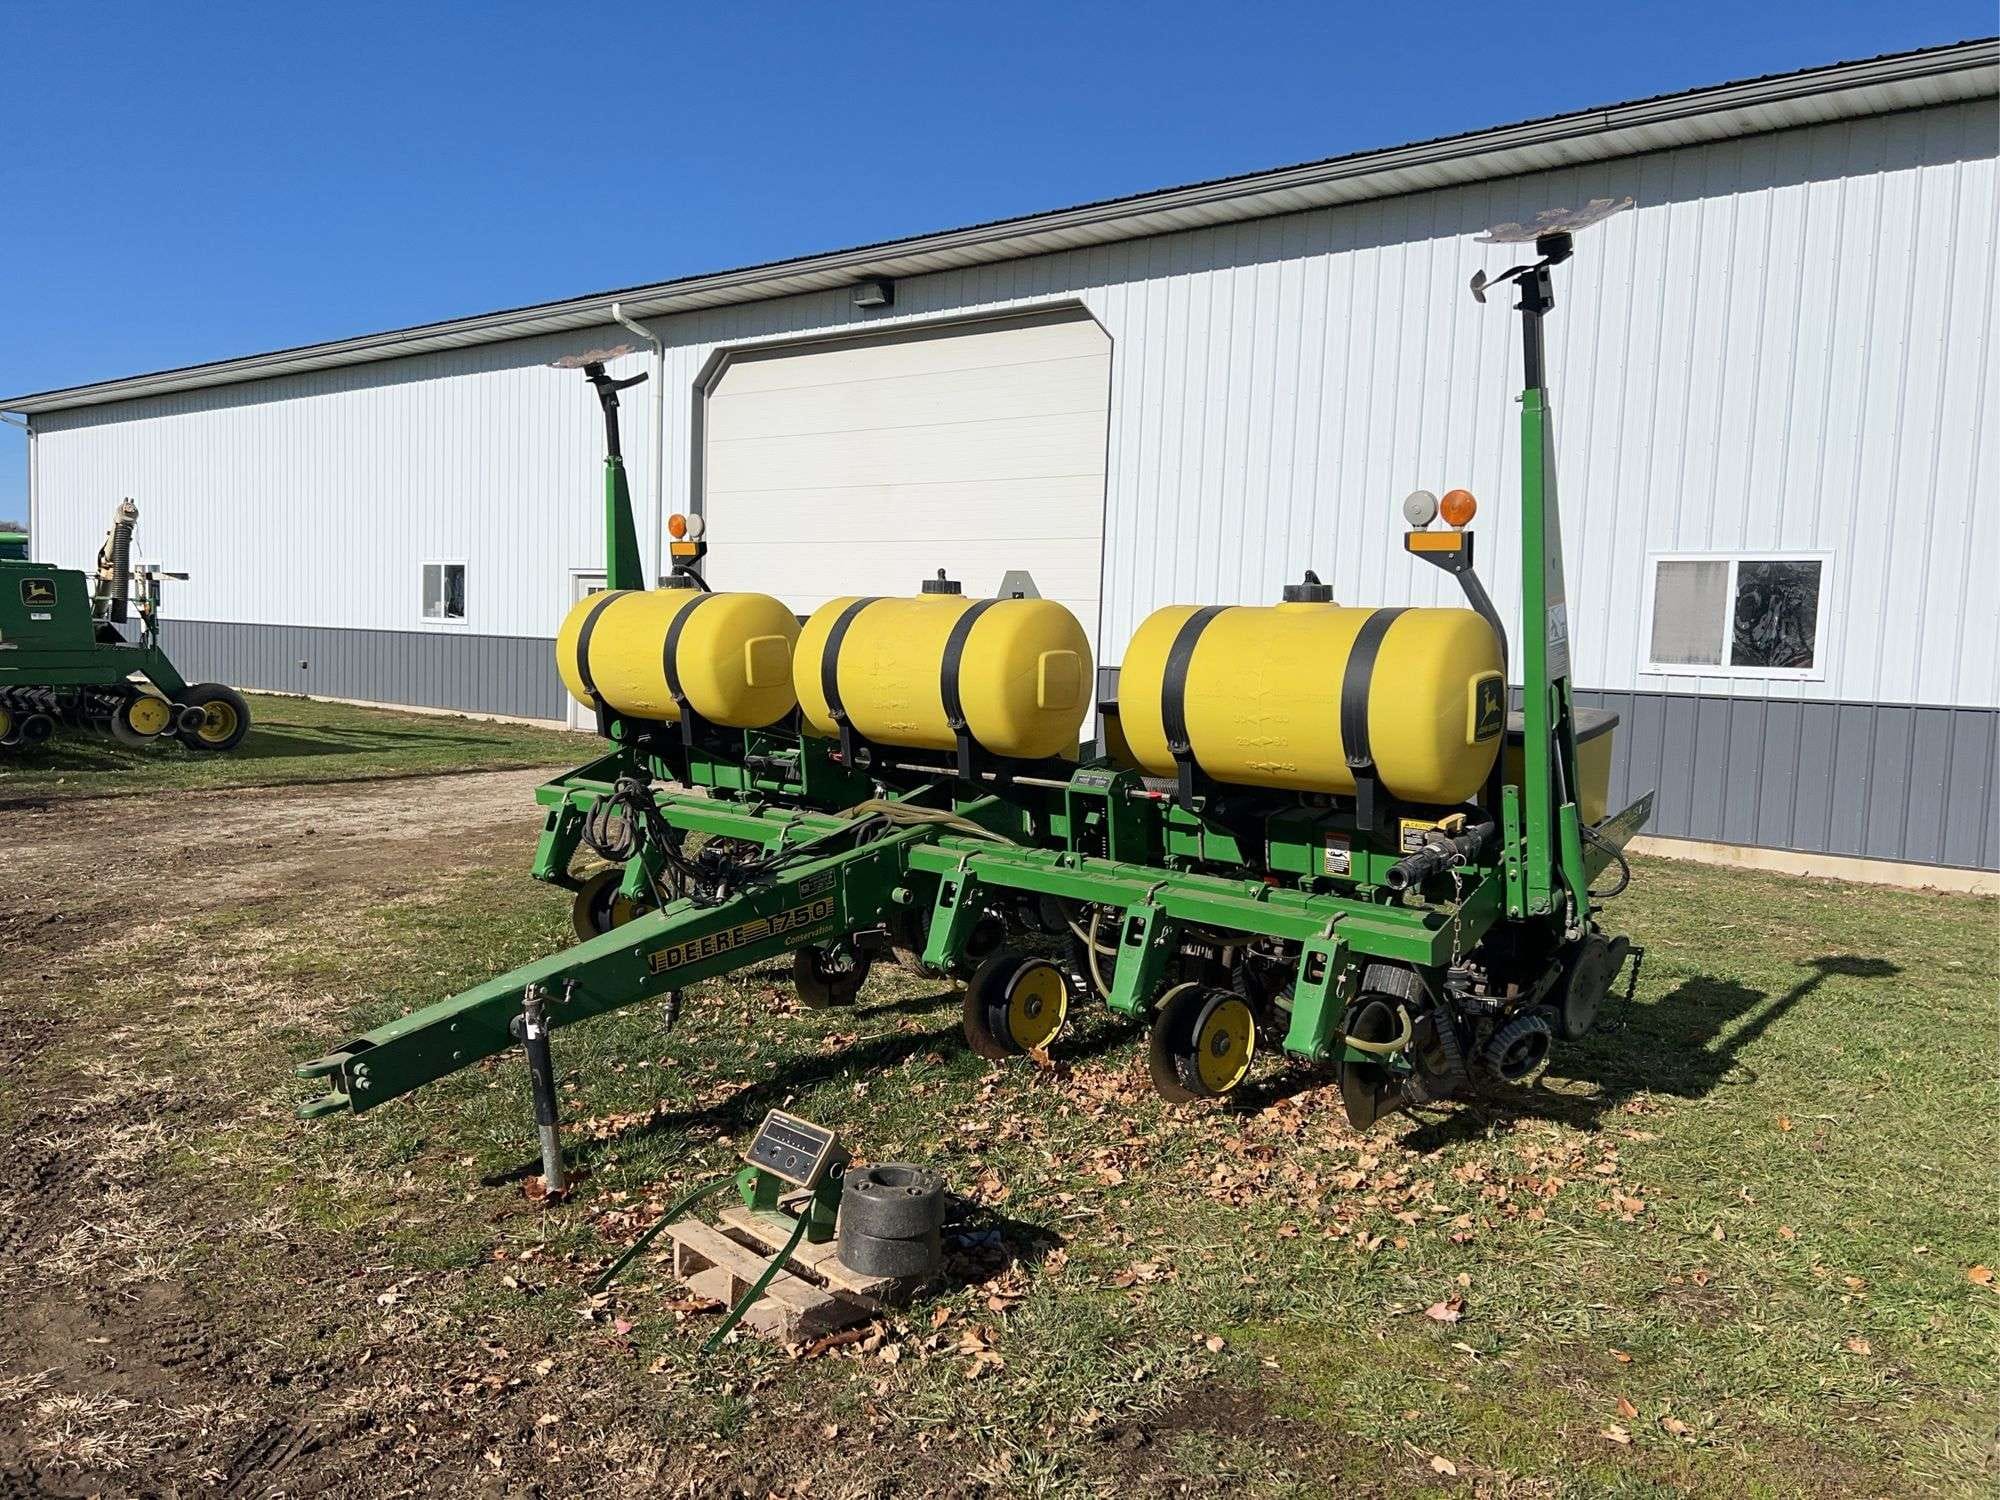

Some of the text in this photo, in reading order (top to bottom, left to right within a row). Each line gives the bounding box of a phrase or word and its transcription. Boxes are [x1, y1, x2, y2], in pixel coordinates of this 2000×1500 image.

[666, 926, 744, 968] DEERE
[768, 900, 828, 935] 1750
[784, 924, 834, 946] Conservation
